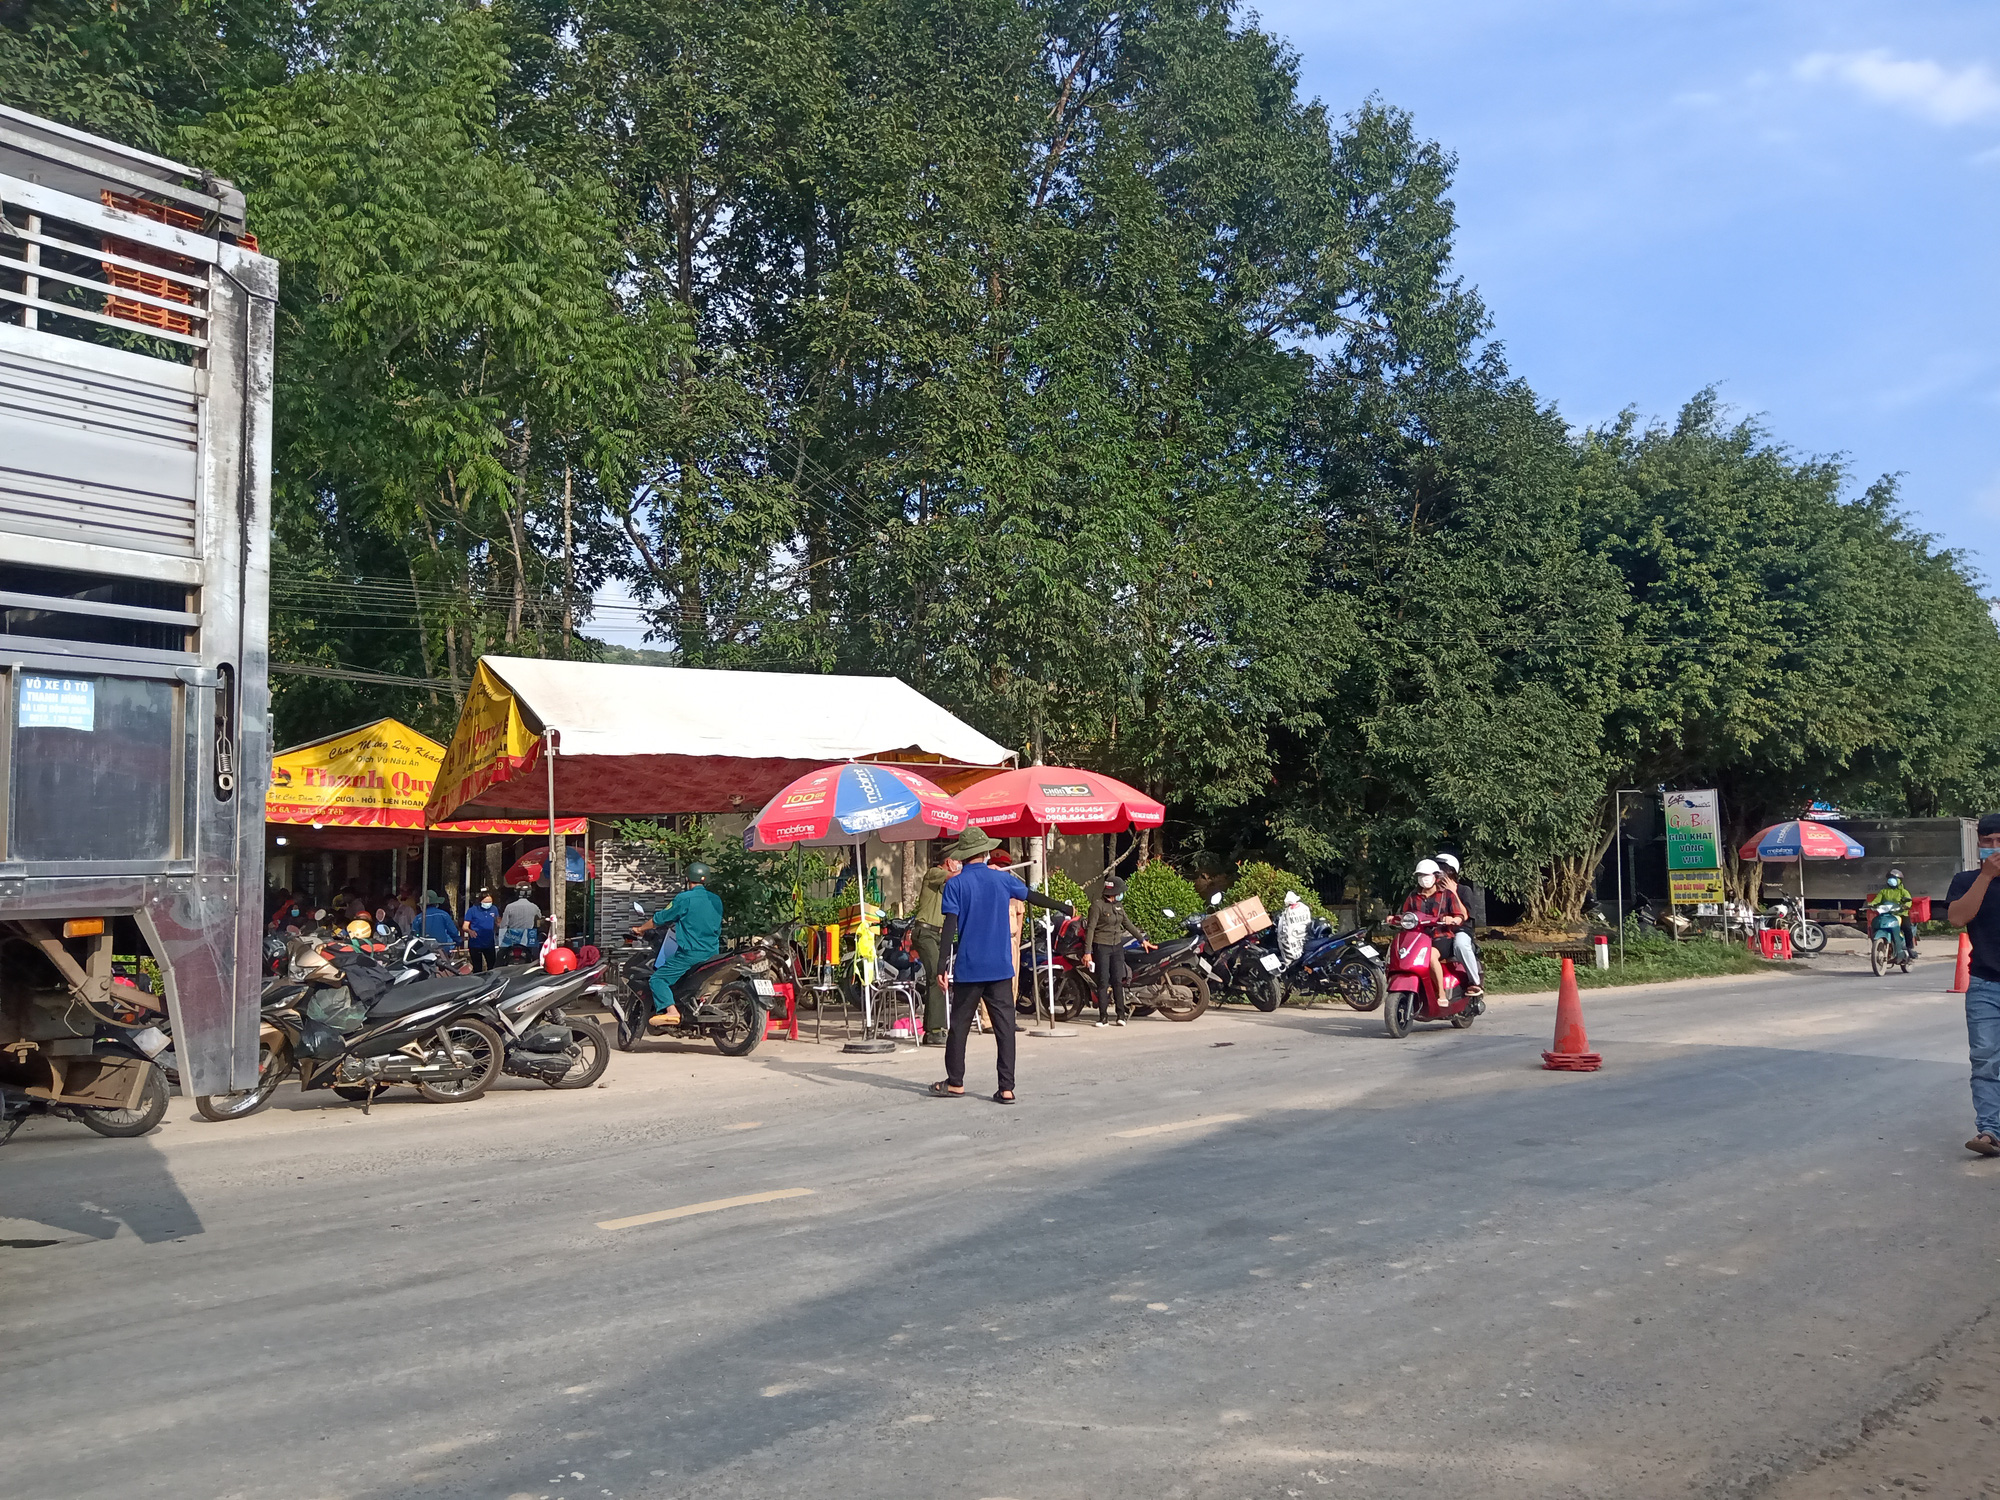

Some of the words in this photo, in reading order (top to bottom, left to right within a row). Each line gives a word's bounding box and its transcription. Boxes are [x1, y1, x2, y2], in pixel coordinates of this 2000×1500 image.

[45, 680, 60, 690] XE
[63, 680, 71, 691] Ô
[75, 681, 88, 692] TÔ
[301, 766, 385, 789] Thanh
[1682, 856, 1703, 864] WIFI
